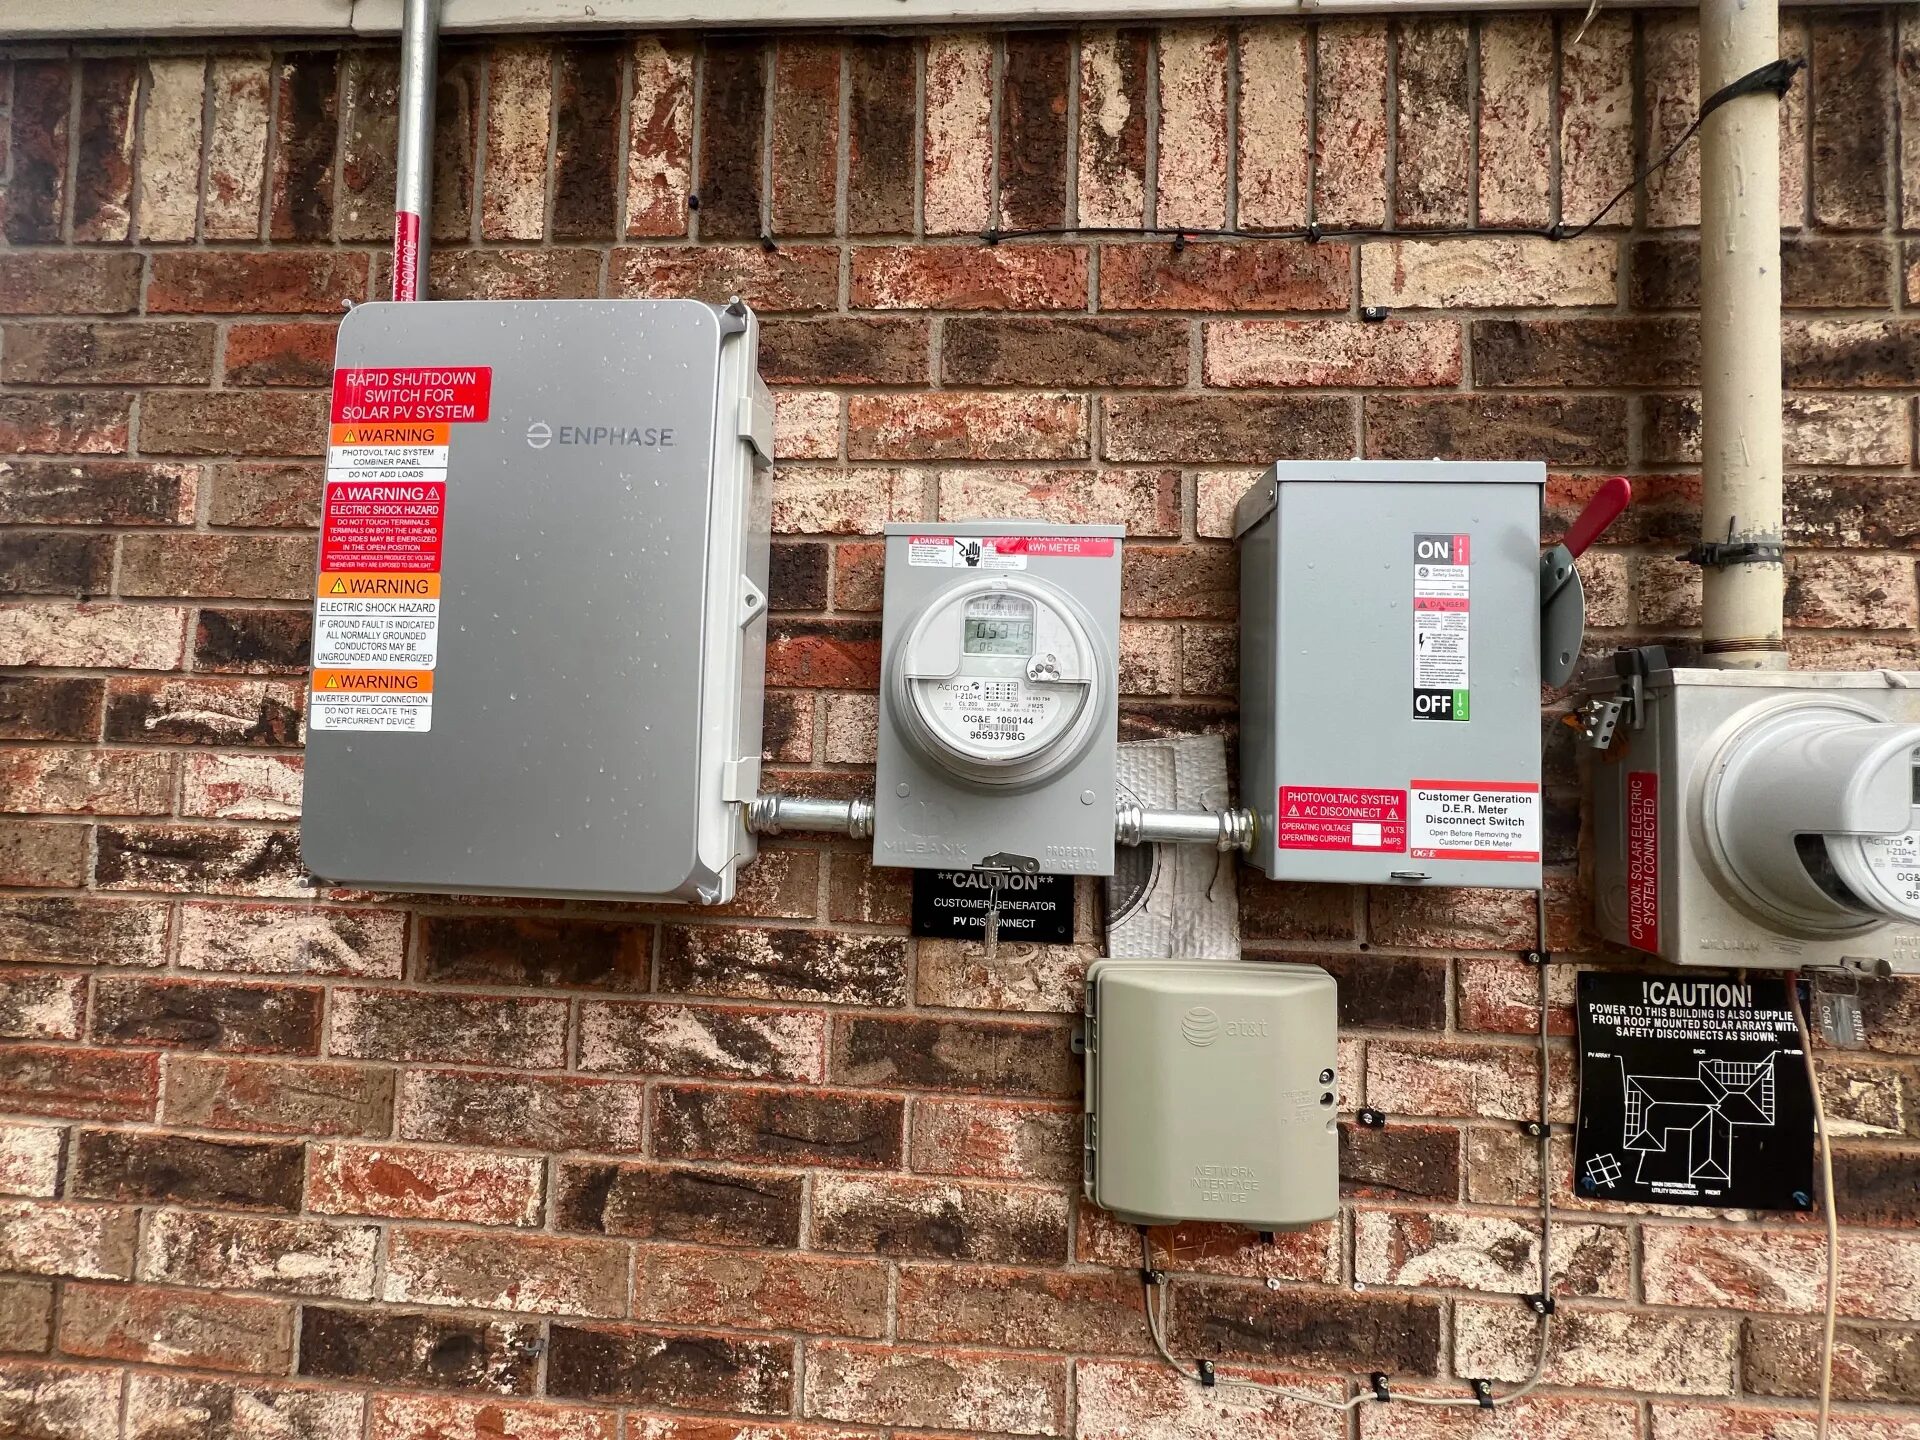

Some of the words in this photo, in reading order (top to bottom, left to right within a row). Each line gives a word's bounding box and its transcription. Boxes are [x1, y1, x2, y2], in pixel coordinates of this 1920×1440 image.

[402, 240, 416, 288] SOURCE
[346, 373, 389, 386] RAPID
[393, 372, 476, 385] SHUTDOWN
[365, 389, 419, 402] SWITCH
[424, 389, 454, 401] FOR
[342, 407, 389, 419] SOLAR
[394, 406, 412, 418] PV
[416, 405, 475, 418] SYSTEM
[359, 429, 435, 441] WARNING
[559, 426, 674, 446] ENPHASE
[348, 488, 423, 500] WARNING
[331, 506, 371, 515] ELECTRIC
[373, 506, 402, 515] SHOCK
[404, 506, 438, 515] HAZARD
[1029, 544, 1046, 552] kWh
[1049, 544, 1080, 552] METER
[1418, 541, 1448, 559] ON
[350, 579, 428, 594] WARNING
[321, 602, 362, 612] ELECTRIC
[366, 602, 396, 612] SHOCK
[399, 603, 435, 612] HAZARD
[319, 620, 326, 628] IF
[327, 620, 360, 628] GROUND
[362, 620, 384, 628] FAULT
[386, 620, 393, 628] IS
[396, 620, 435, 629] INDICATED
[326, 631, 339, 639] ALL
[341, 631, 380, 640] NORMALLY
[383, 631, 426, 640] GROUNDED
[335, 642, 387, 650] CONDUCTORS
[389, 643, 404, 651] MAY
[407, 643, 416, 651] BE
[318, 653, 370, 661] UNGROUNDED
[390, 654, 433, 662] ENERGIZED
[341, 675, 418, 689] WARNING
[937, 683, 969, 691] Aclara
[382, 695, 428, 703] CONNECTION
[1416, 695, 1451, 713] OFF
[326, 717, 385, 725] OVERCURRENT
[963, 715, 990, 723] OG&E
[997, 716, 1033, 724] 1060144
[970, 731, 1025, 740] 96593798G
[1288, 792, 1358, 804] PHOTOVOLTAIC
[1361, 795, 1398, 805] SYSTEM
[1418, 792, 1469, 802] Customer
[1473, 794, 1532, 803] Generation
[1305, 807, 1317, 815] AC
[1320, 807, 1381, 817] DISCONNECT
[1442, 804, 1475, 813] D.E.R.
[1478, 806, 1508, 814] Meter
[1631, 780, 1642, 838] ELECTRIC
[1426, 815, 1486, 825] Disconnect
[1489, 817, 1524, 826] Switch
[1282, 823, 1319, 831] OPERATING
[1321, 824, 1350, 832] VOLTAGE
[1282, 834, 1318, 842] OPERATING
[1320, 835, 1351, 843] CURRENT
[1475, 831, 1509, 839] Removing
[1643, 798, 1655, 873] CONNECTED
[1631, 844, 1643, 881] SOLAR
[1643, 879, 1655, 926] SYSTEM
[1631, 884, 1644, 940] CAUTION:
[953, 917, 967, 925] PV
[969, 918, 1036, 929] DISONNECT
[1642, 981, 1752, 1008] !CAUTION!
[1590, 1003, 1625, 1015] POWER
[1629, 1006, 1642, 1016] TO
[1645, 1007, 1667, 1017] THIS
[1670, 1008, 1714, 1019] BUILDING
[1717, 1010, 1725, 1019] IS
[1728, 1010, 1752, 1020] ALSO
[1754, 1010, 1793, 1021] SUPPLIE
[1225, 1018, 1268, 1037] at&t
[1592, 1014, 1620, 1025] FROM
[1623, 1016, 1651, 1027] ROOF
[1654, 1018, 1699, 1029] MOUNTED
[1703, 1020, 1733, 1030] SOLAR
[1736, 1021, 1773, 1031] ARRAYS
[1616, 1027, 1654, 1038] SAFETY
[1657, 1029, 1724, 1040] DISCONNECTS
[1726, 1031, 1738, 1040] AS
[1739, 1032, 1778, 1042] SHOWN:
[1195, 1165, 1255, 1177] NETWORK
[1191, 1177, 1259, 1191] INTERFACE
[1607, 1181, 1615, 1189] N
[1202, 1191, 1247, 1203] DEVICE
